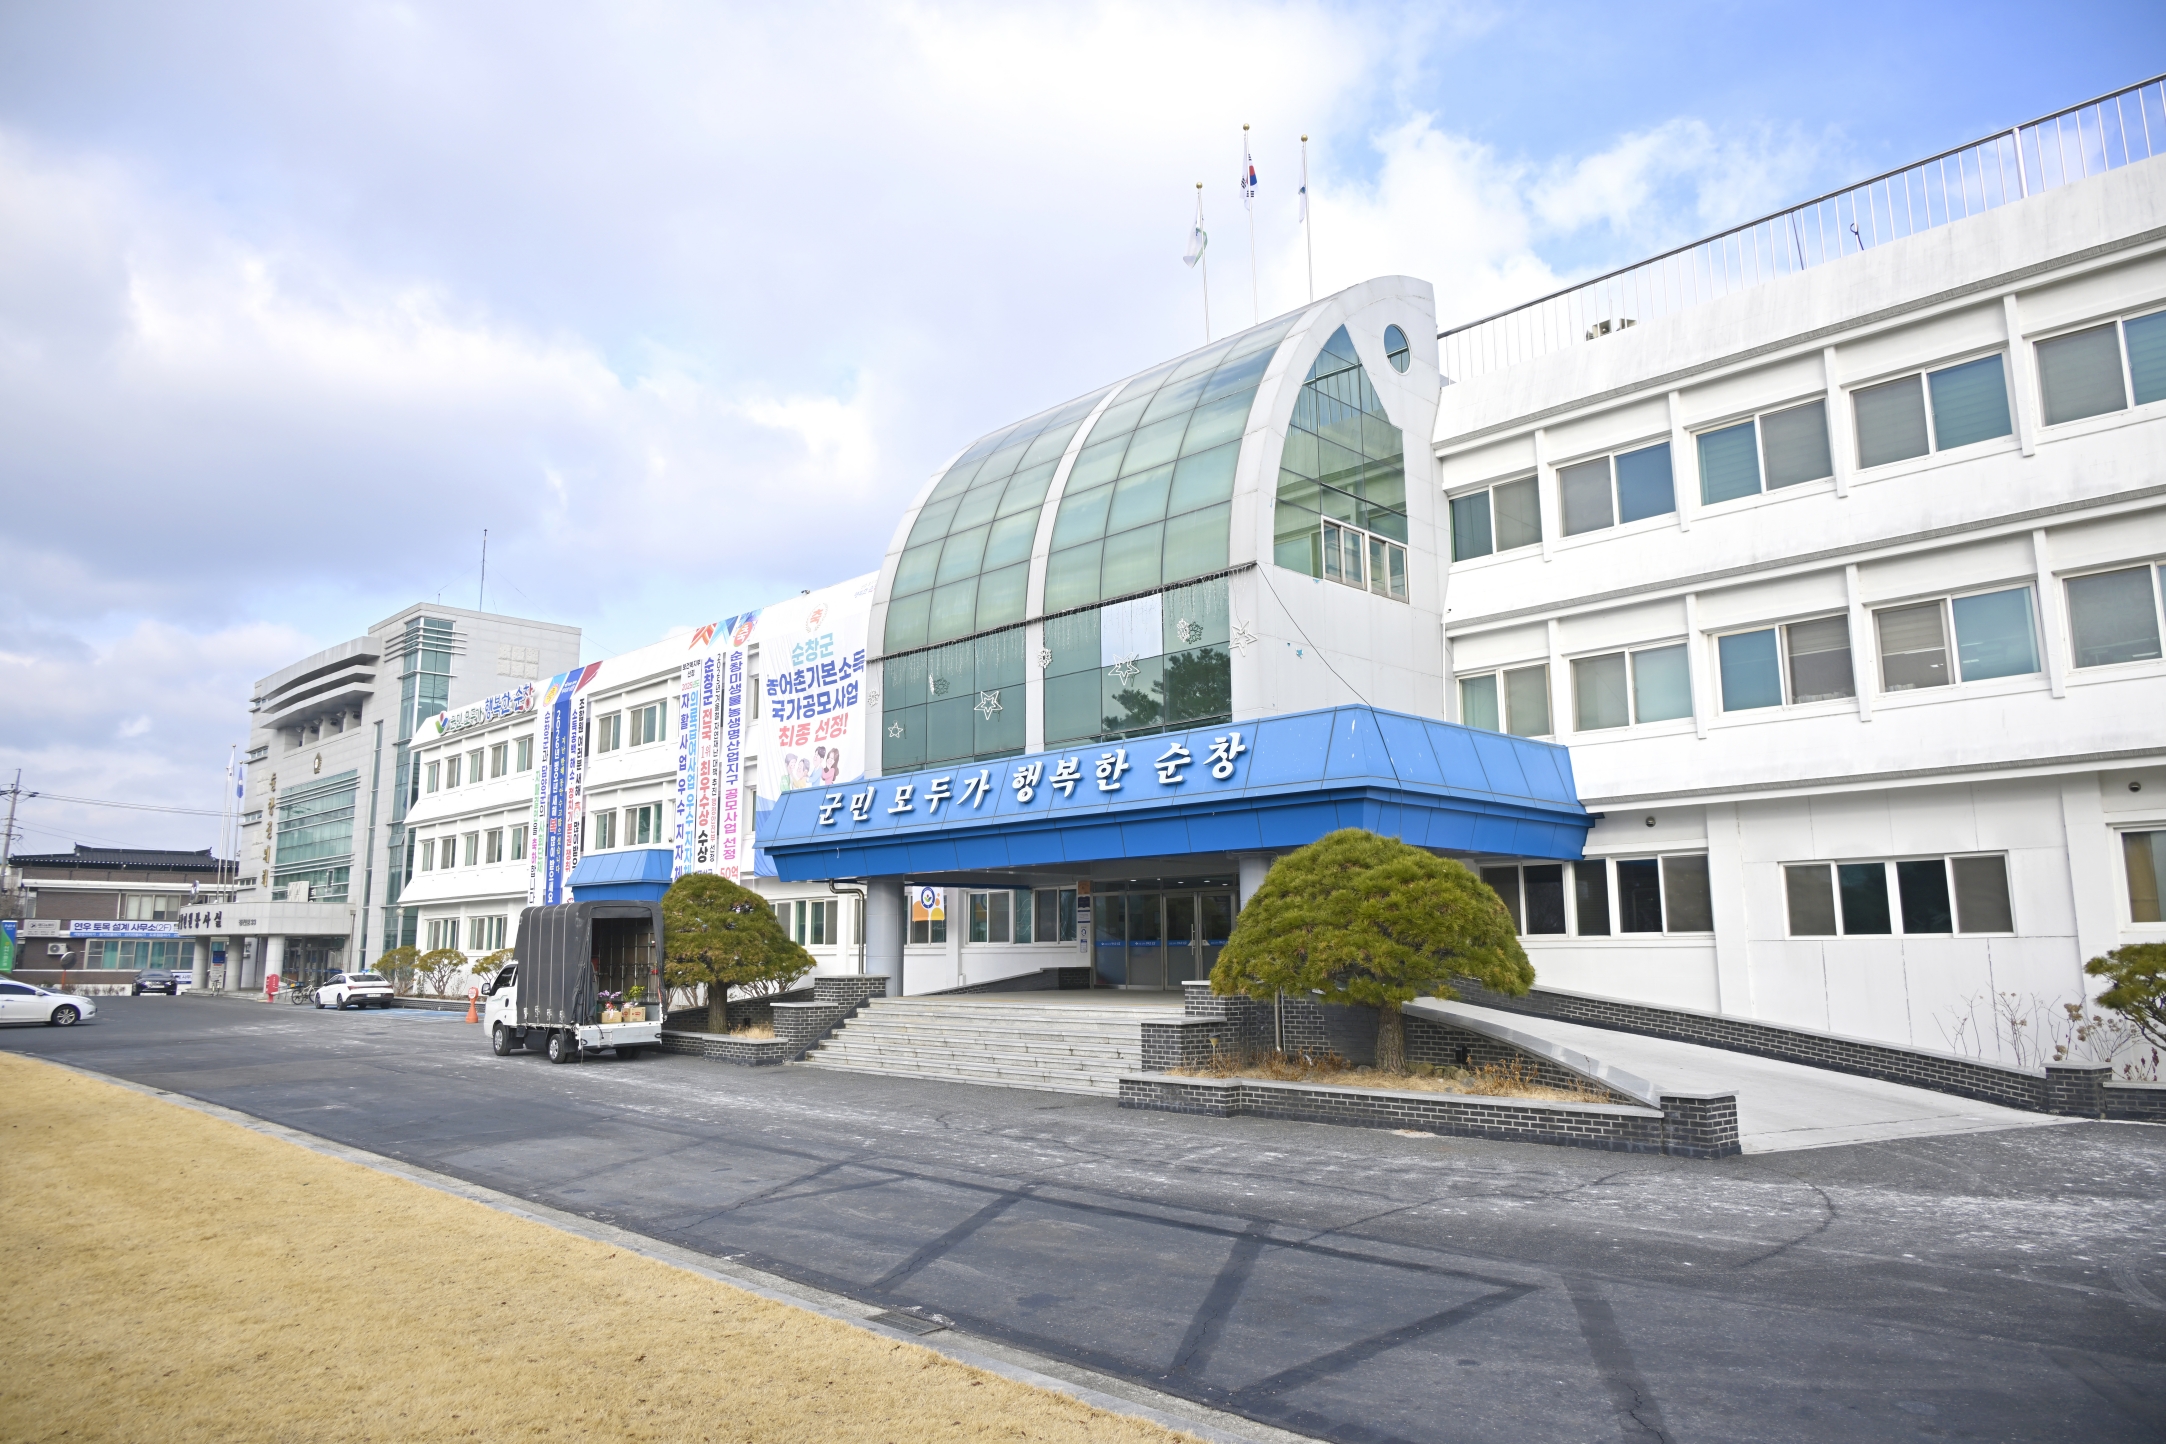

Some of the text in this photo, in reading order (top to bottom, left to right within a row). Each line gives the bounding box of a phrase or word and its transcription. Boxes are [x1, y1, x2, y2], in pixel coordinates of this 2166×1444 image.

[810, 608, 823, 624] 축
[791, 632, 834, 666] 순창군
[703, 657, 715, 707] 순창군
[766, 648, 866, 697] 농어촌기본소득
[485, 691, 512, 720] 행복한
[514, 682, 535, 711] 순창
[772, 680, 859, 722] 국가공모사업
[701, 708, 713, 741] 전국
[778, 712, 849, 747] 최종 선정!
[701, 745, 712, 759] 1위
[698, 759, 711, 827] 최우수상
[818, 730, 1247, 827] 군민 모두가 행복한 순창
[676, 778, 686, 816] 우수
[685, 793, 695, 828] 우수
[723, 788, 738, 835] 공모사업
[697, 829, 709, 863] 수상
[723, 837, 736, 860] 선정
